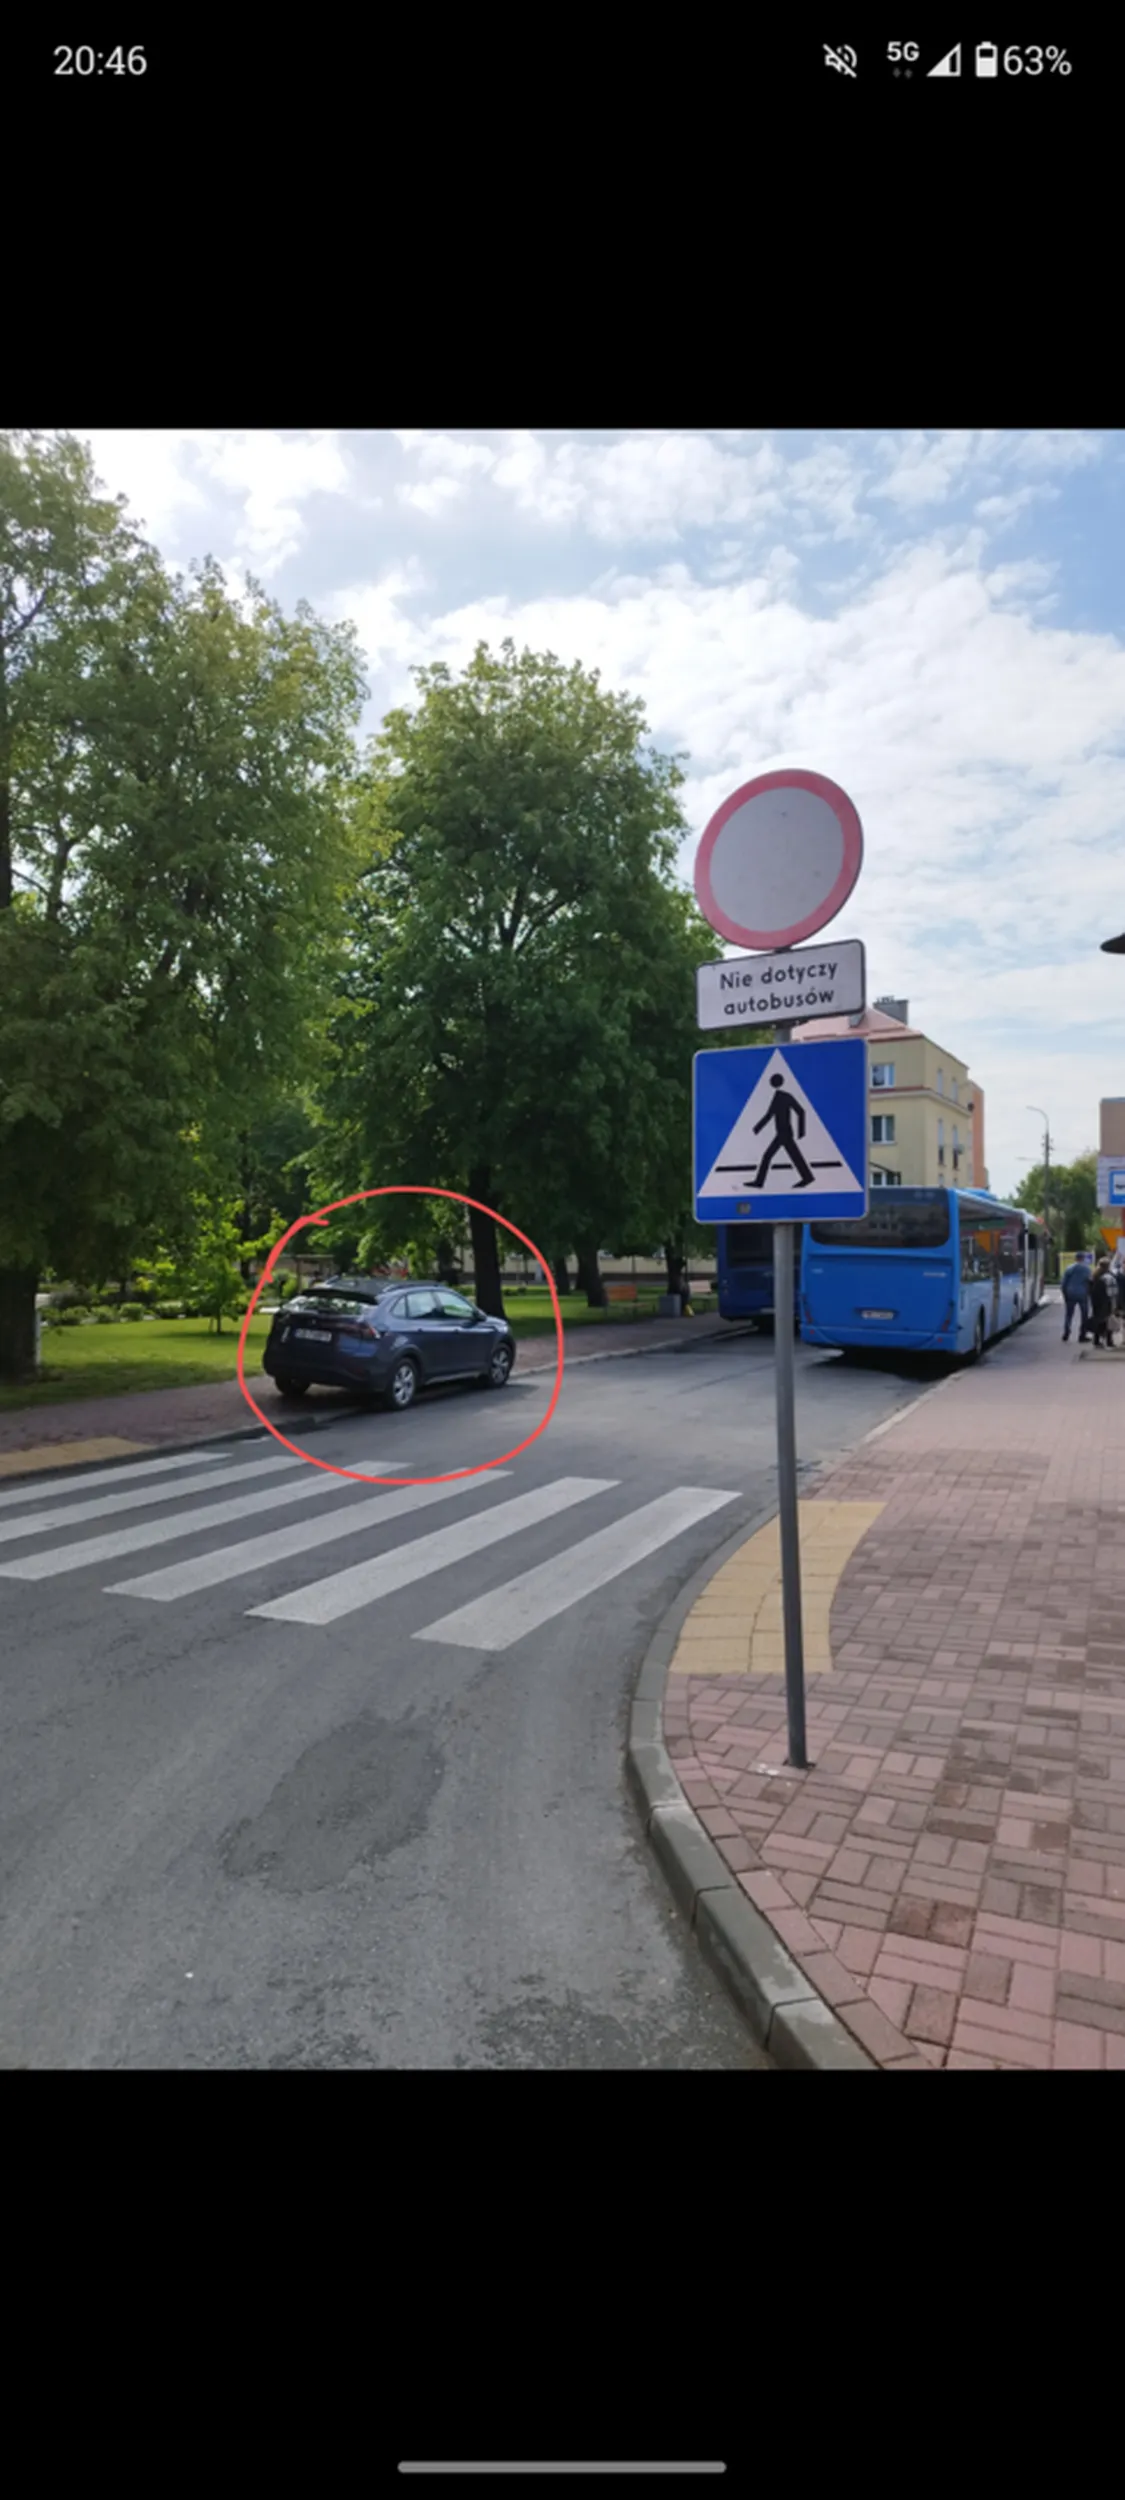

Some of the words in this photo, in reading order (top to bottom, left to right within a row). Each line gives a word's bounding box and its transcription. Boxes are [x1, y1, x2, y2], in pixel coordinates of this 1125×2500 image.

[720, 973, 753, 990] Nie
[761, 962, 838, 985] dotyczy
[724, 987, 835, 1015] autobusów
